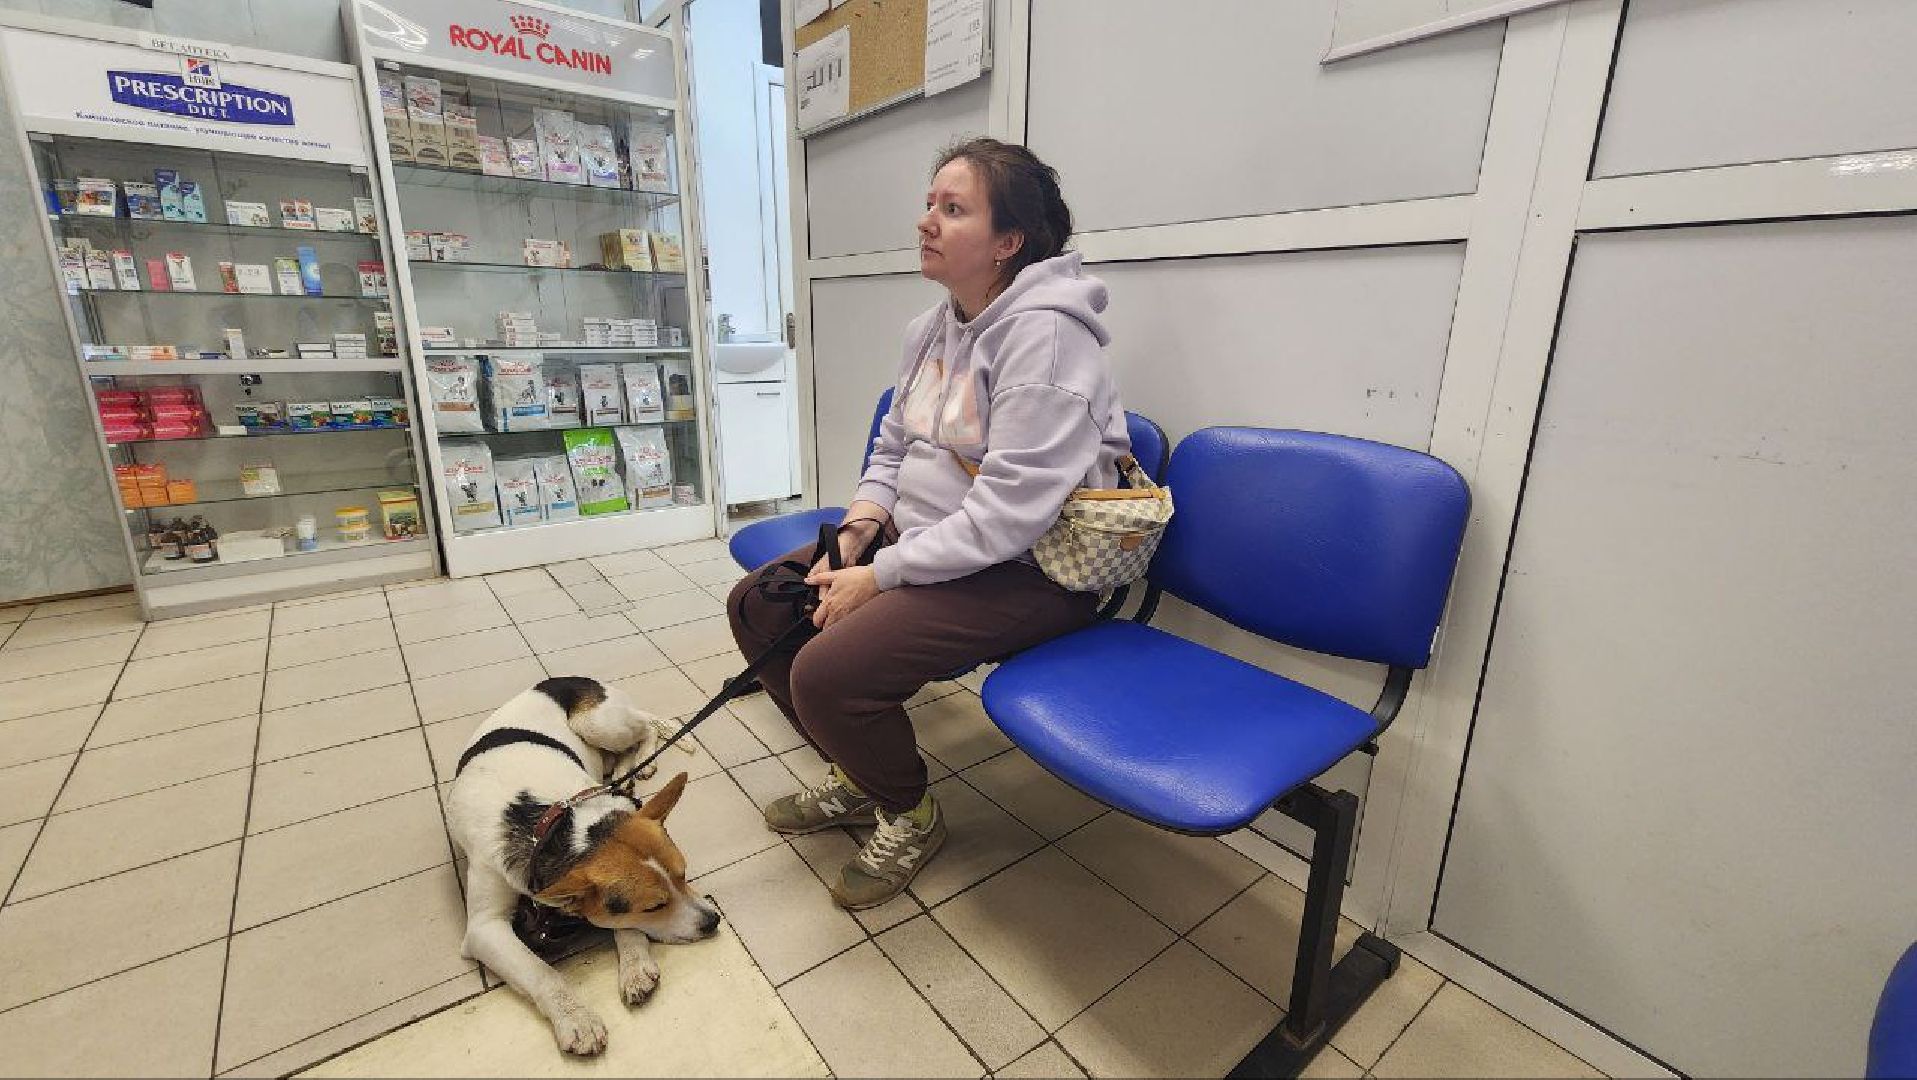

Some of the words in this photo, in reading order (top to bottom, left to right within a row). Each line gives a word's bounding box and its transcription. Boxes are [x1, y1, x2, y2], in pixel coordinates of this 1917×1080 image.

[449, 24, 531, 60] ROYAL
[536, 42, 612, 75] CANIN
[114, 75, 288, 116] PRESCRIPTION
[818, 797, 847, 818] N
[897, 846, 922, 869] N
